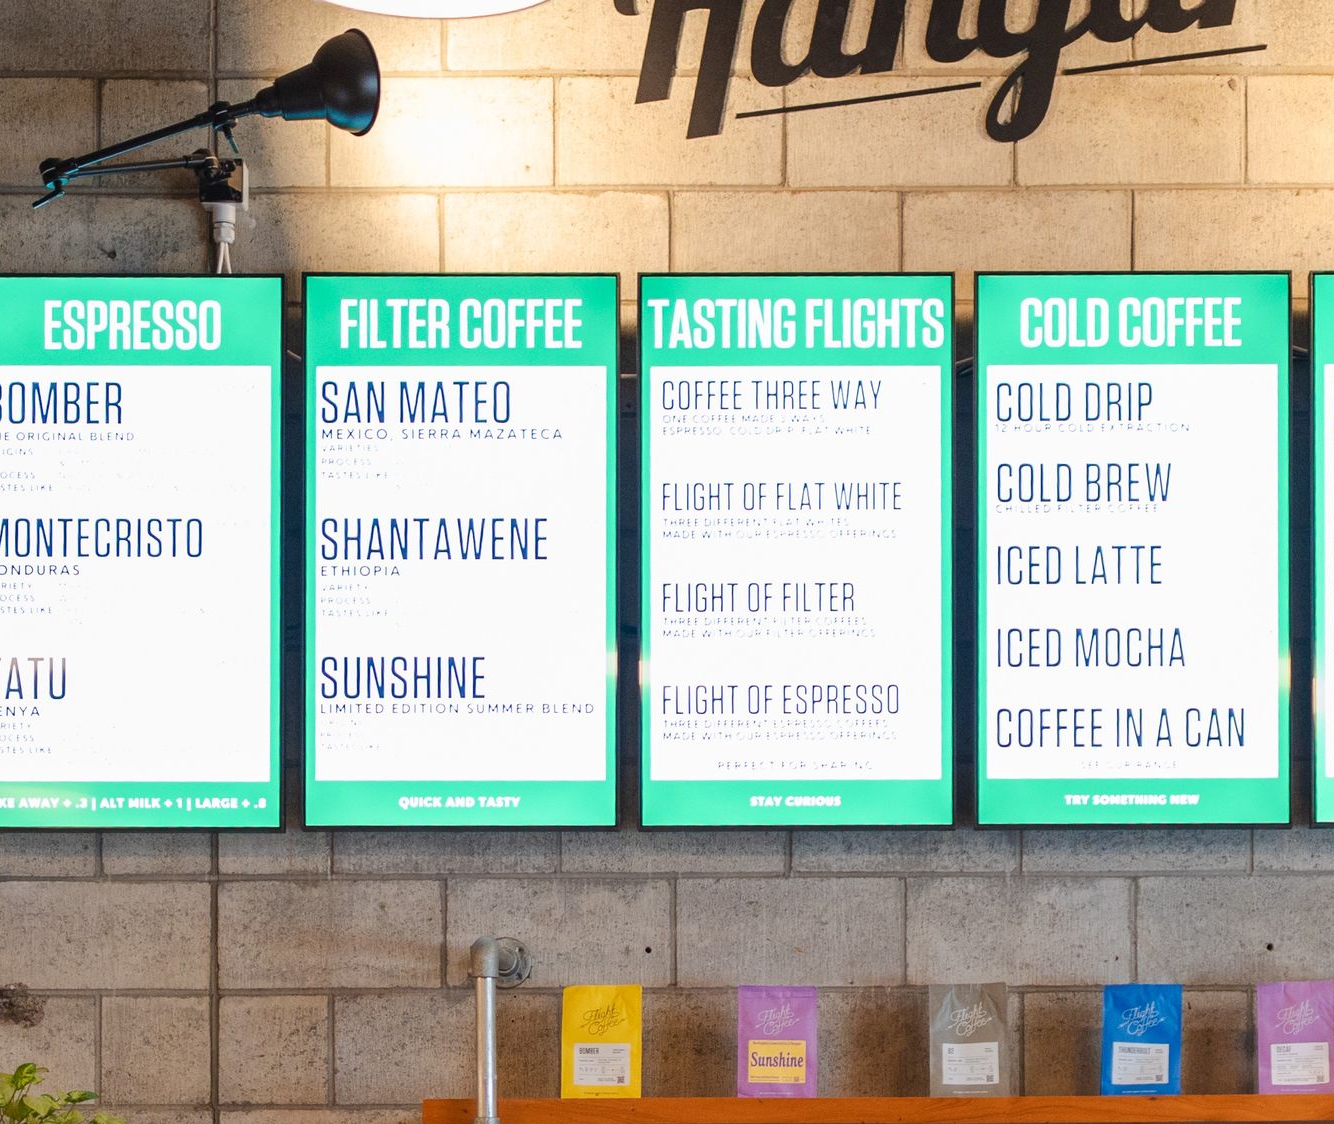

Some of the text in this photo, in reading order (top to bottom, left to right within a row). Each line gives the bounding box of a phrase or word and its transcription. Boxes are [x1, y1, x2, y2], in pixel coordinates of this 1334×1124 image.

[44, 299, 222, 351] ESPRESSO
[340, 298, 583, 349] FILTER COFFEE
[647, 297, 945, 349] TASTING FLIGHTS
[1020, 296, 1242, 348] COLD COFFEE
[321, 380, 511, 424] SAN MATEO
[662, 379, 882, 411] COFFEE THREE WAY
[996, 381, 1153, 423] COLD DRIP
[15, 431, 82, 441] ORIGINAL
[90, 432, 134, 441] BLEND
[401, 428, 461, 440] SIERRA
[469, 428, 563, 440] MAZATECA
[662, 481, 902, 512] FLIGHT OF FLAT WHITE
[996, 462, 1172, 503] COLD BREW
[320, 517, 548, 561] SHANTAWENE
[320, 565, 401, 577] ETHIOPIA
[997, 544, 1163, 586] ICED LATTE
[662, 582, 855, 613] FLIGHT OF FILTER
[997, 627, 1186, 668] ICED MOCHA
[320, 655, 486, 700] SUNSHINE
[320, 703, 594, 714] LIMITED EDITION SUMMER BLEND
[662, 684, 900, 715] FLIGHT OF ESPRESSO
[996, 707, 1245, 749] COFFEE IN A CAN
[18, 796, 60, 809] AWAY
[100, 796, 125, 809] ALT
[128, 796, 162, 809] MILK
[195, 796, 239, 809] LARGE
[398, 796, 521, 810] QUICK AND TASTY
[750, 795, 842, 807] STAY CURIOUS
[1064, 794, 1200, 806] TRY SOMETHING NEW
[750, 1051, 804, 1067] Sunshine
